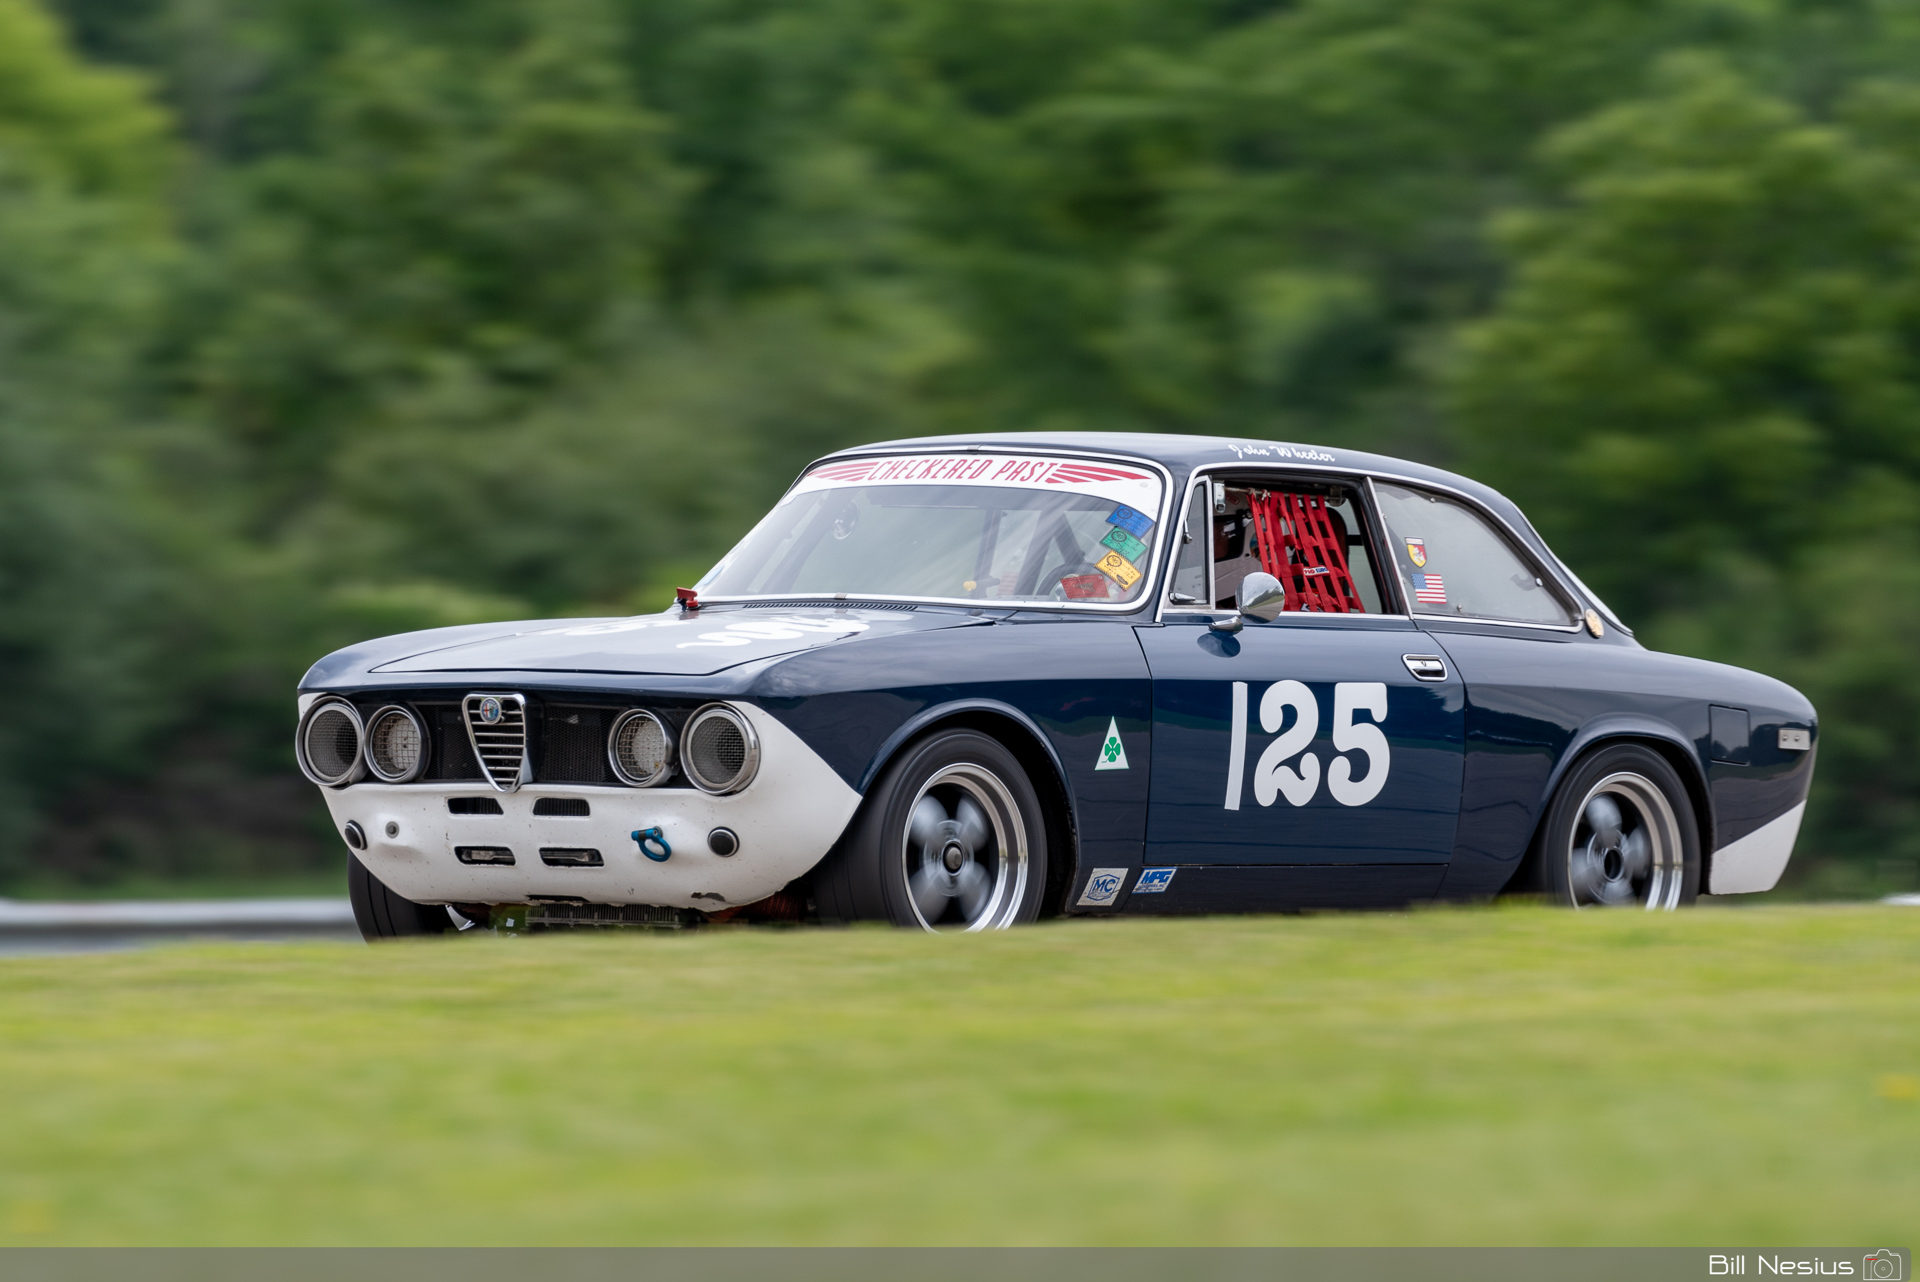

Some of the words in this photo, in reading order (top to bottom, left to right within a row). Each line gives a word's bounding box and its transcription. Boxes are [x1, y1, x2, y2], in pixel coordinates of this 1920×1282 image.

[1228, 444, 1270, 459] John
[1269, 445, 1336, 462] Wheeler
[867, 459, 994, 480] CHECKERED
[991, 460, 1058, 482] PAST
[1224, 679, 1391, 811] 125
[1092, 879, 1116, 893] MC
[1140, 870, 1173, 884] MPG
